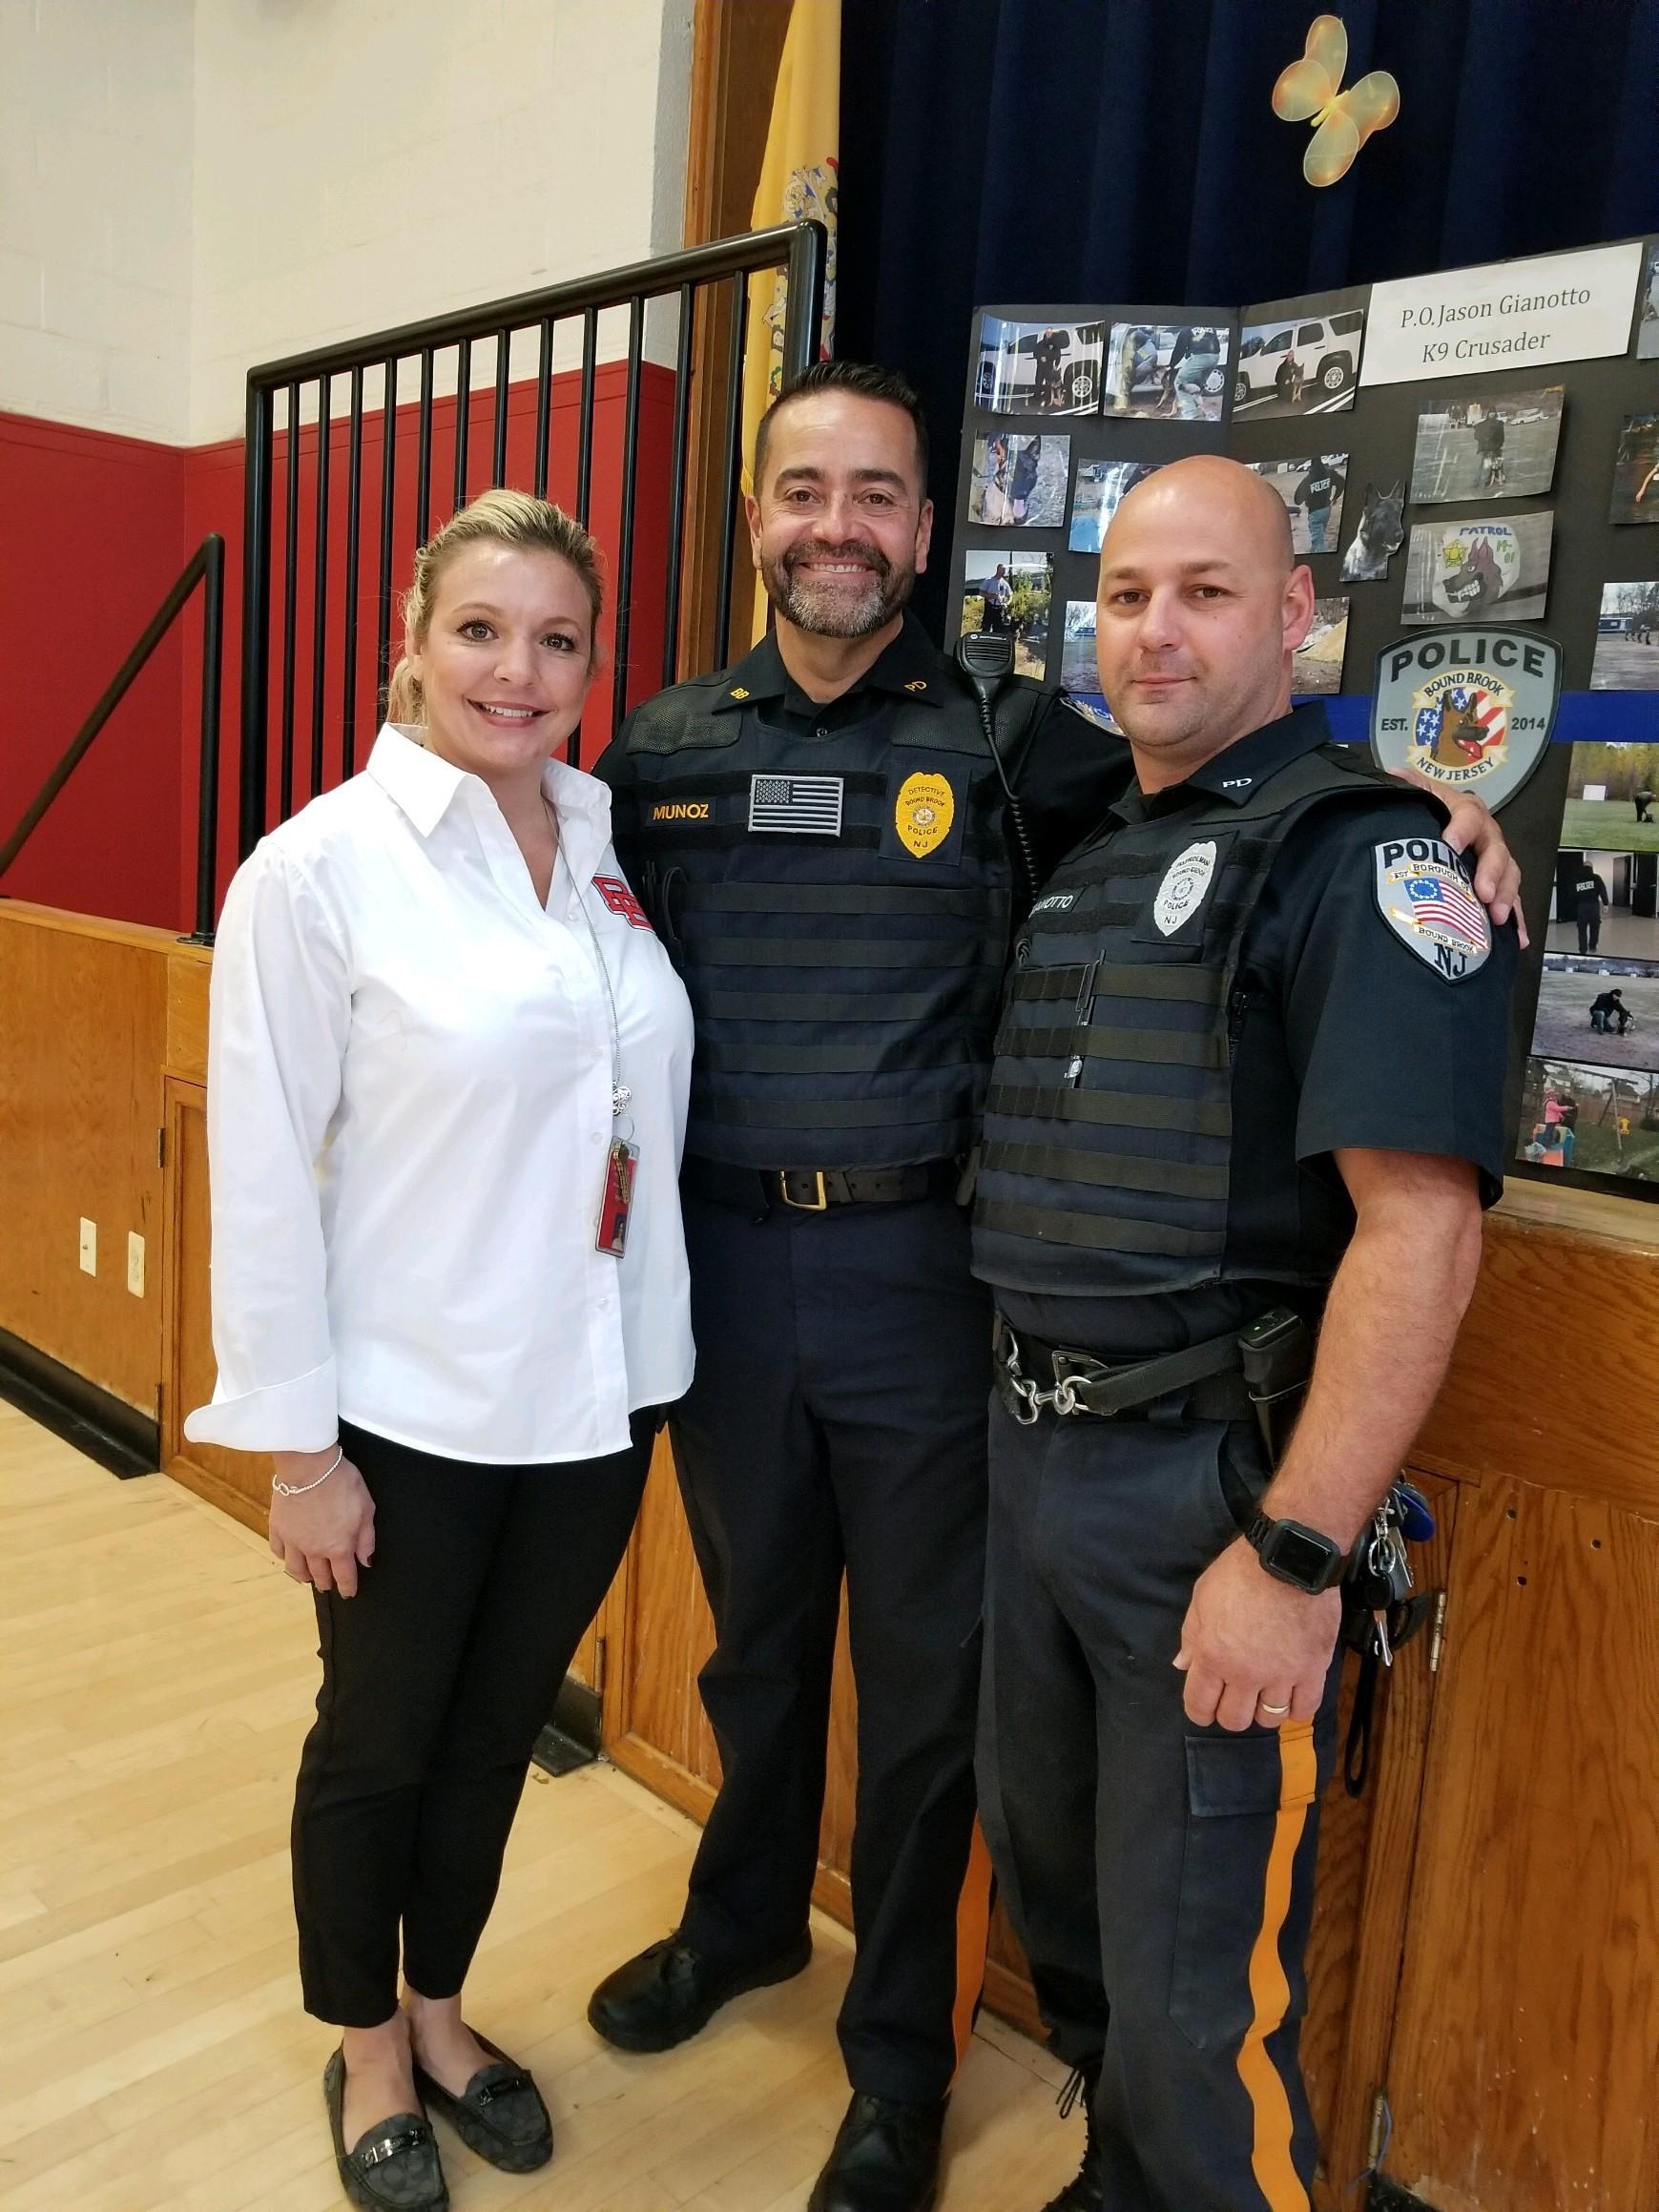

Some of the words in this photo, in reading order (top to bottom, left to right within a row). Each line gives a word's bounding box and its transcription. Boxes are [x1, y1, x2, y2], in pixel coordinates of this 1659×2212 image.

[1499, 288, 1591, 315] Gianotto
[1421, 342, 1449, 363] K9
[1455, 331, 1551, 359] Crusader
[1310, 478, 1331, 493] POLICE
[1459, 526, 1512, 536] PATROL
[1391, 638, 1546, 683] POLICE
[730, 687, 750, 700] BB
[904, 680, 927, 693] PD
[1423, 672, 1465, 698] BOUND
[1466, 672, 1505, 696] BROOK
[1381, 718, 1408, 732] EST.
[1511, 717, 1546, 731] 2014
[1416, 756, 1446, 779] NEW
[1446, 756, 1495, 781] JERSEY
[1222, 777, 1253, 788] PD
[653, 803, 709, 820] MUNOZ
[907, 824, 939, 837] POLICE
[1383, 839, 1471, 884] POLIC
[1394, 870, 1409, 879] EST
[1413, 863, 1459, 884] BOROUGH
[1163, 899, 1190, 910] POLICE
[1418, 927, 1449, 943] BOUND
[1451, 939, 1474, 952] BROOK
[1434, 942, 1467, 978] NJ
